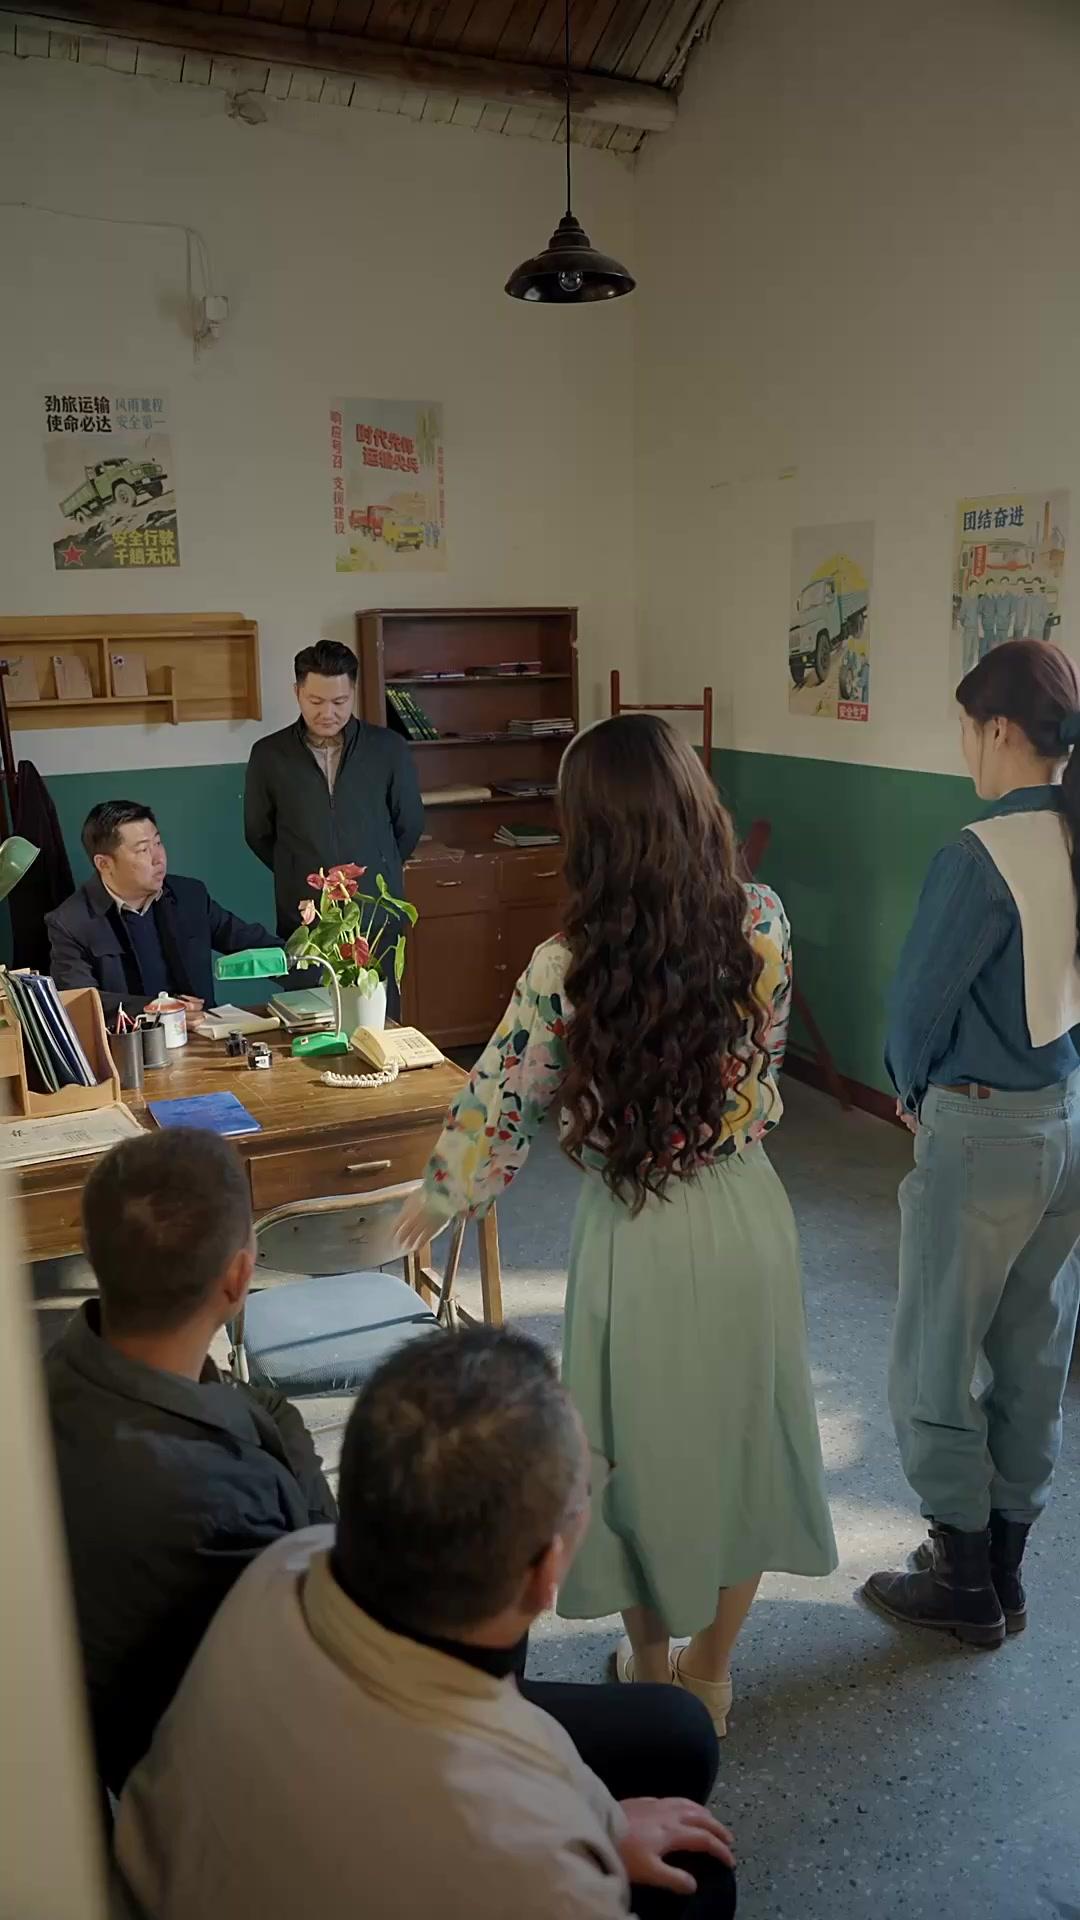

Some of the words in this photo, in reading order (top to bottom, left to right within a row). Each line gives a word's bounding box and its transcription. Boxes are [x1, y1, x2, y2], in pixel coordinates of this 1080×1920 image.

[44, 395, 111, 414] 劲旅运输
[46, 414, 112, 433] 使命必达
[963, 505, 1024, 532] 团结奋进
